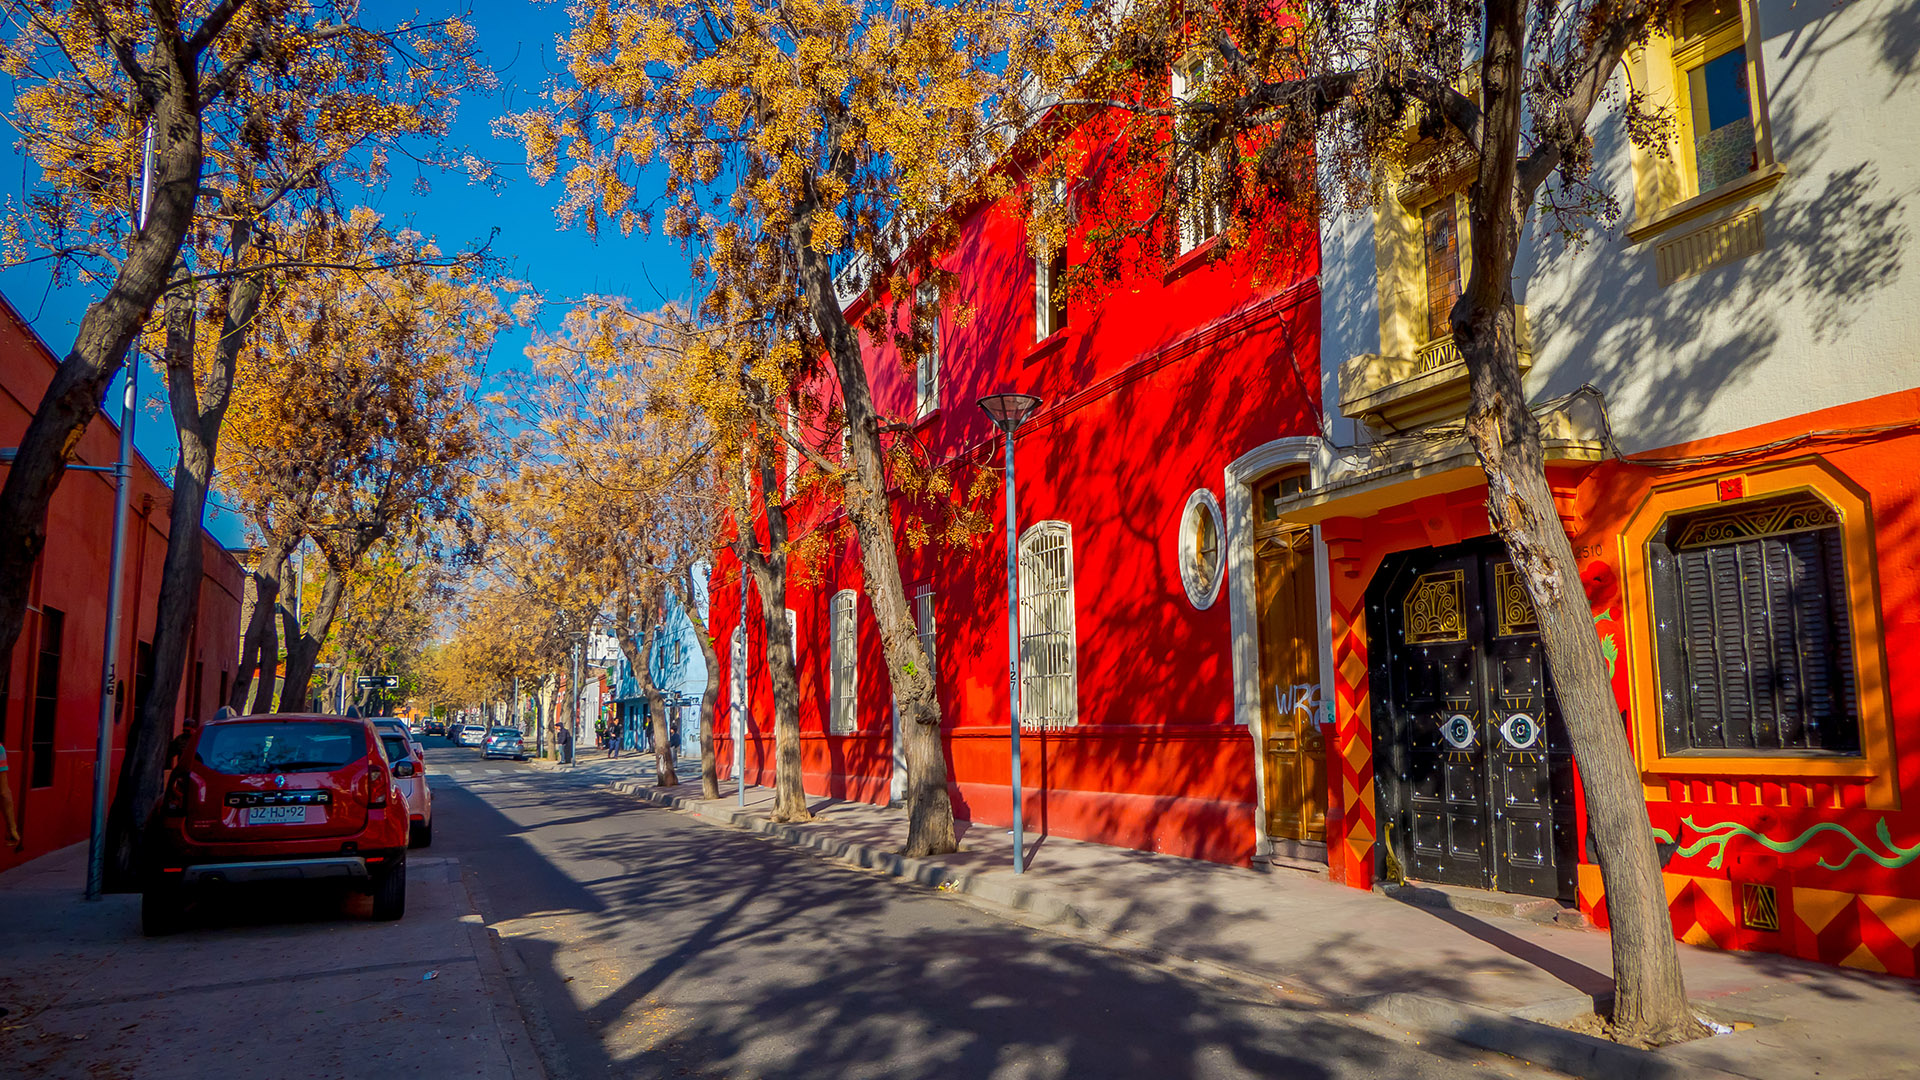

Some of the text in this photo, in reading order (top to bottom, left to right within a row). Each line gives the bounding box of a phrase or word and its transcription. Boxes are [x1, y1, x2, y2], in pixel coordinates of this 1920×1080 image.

[1575, 544, 1602, 559] 2510
[107, 664, 115, 695] 126
[229, 794, 328, 804] DUSTER
